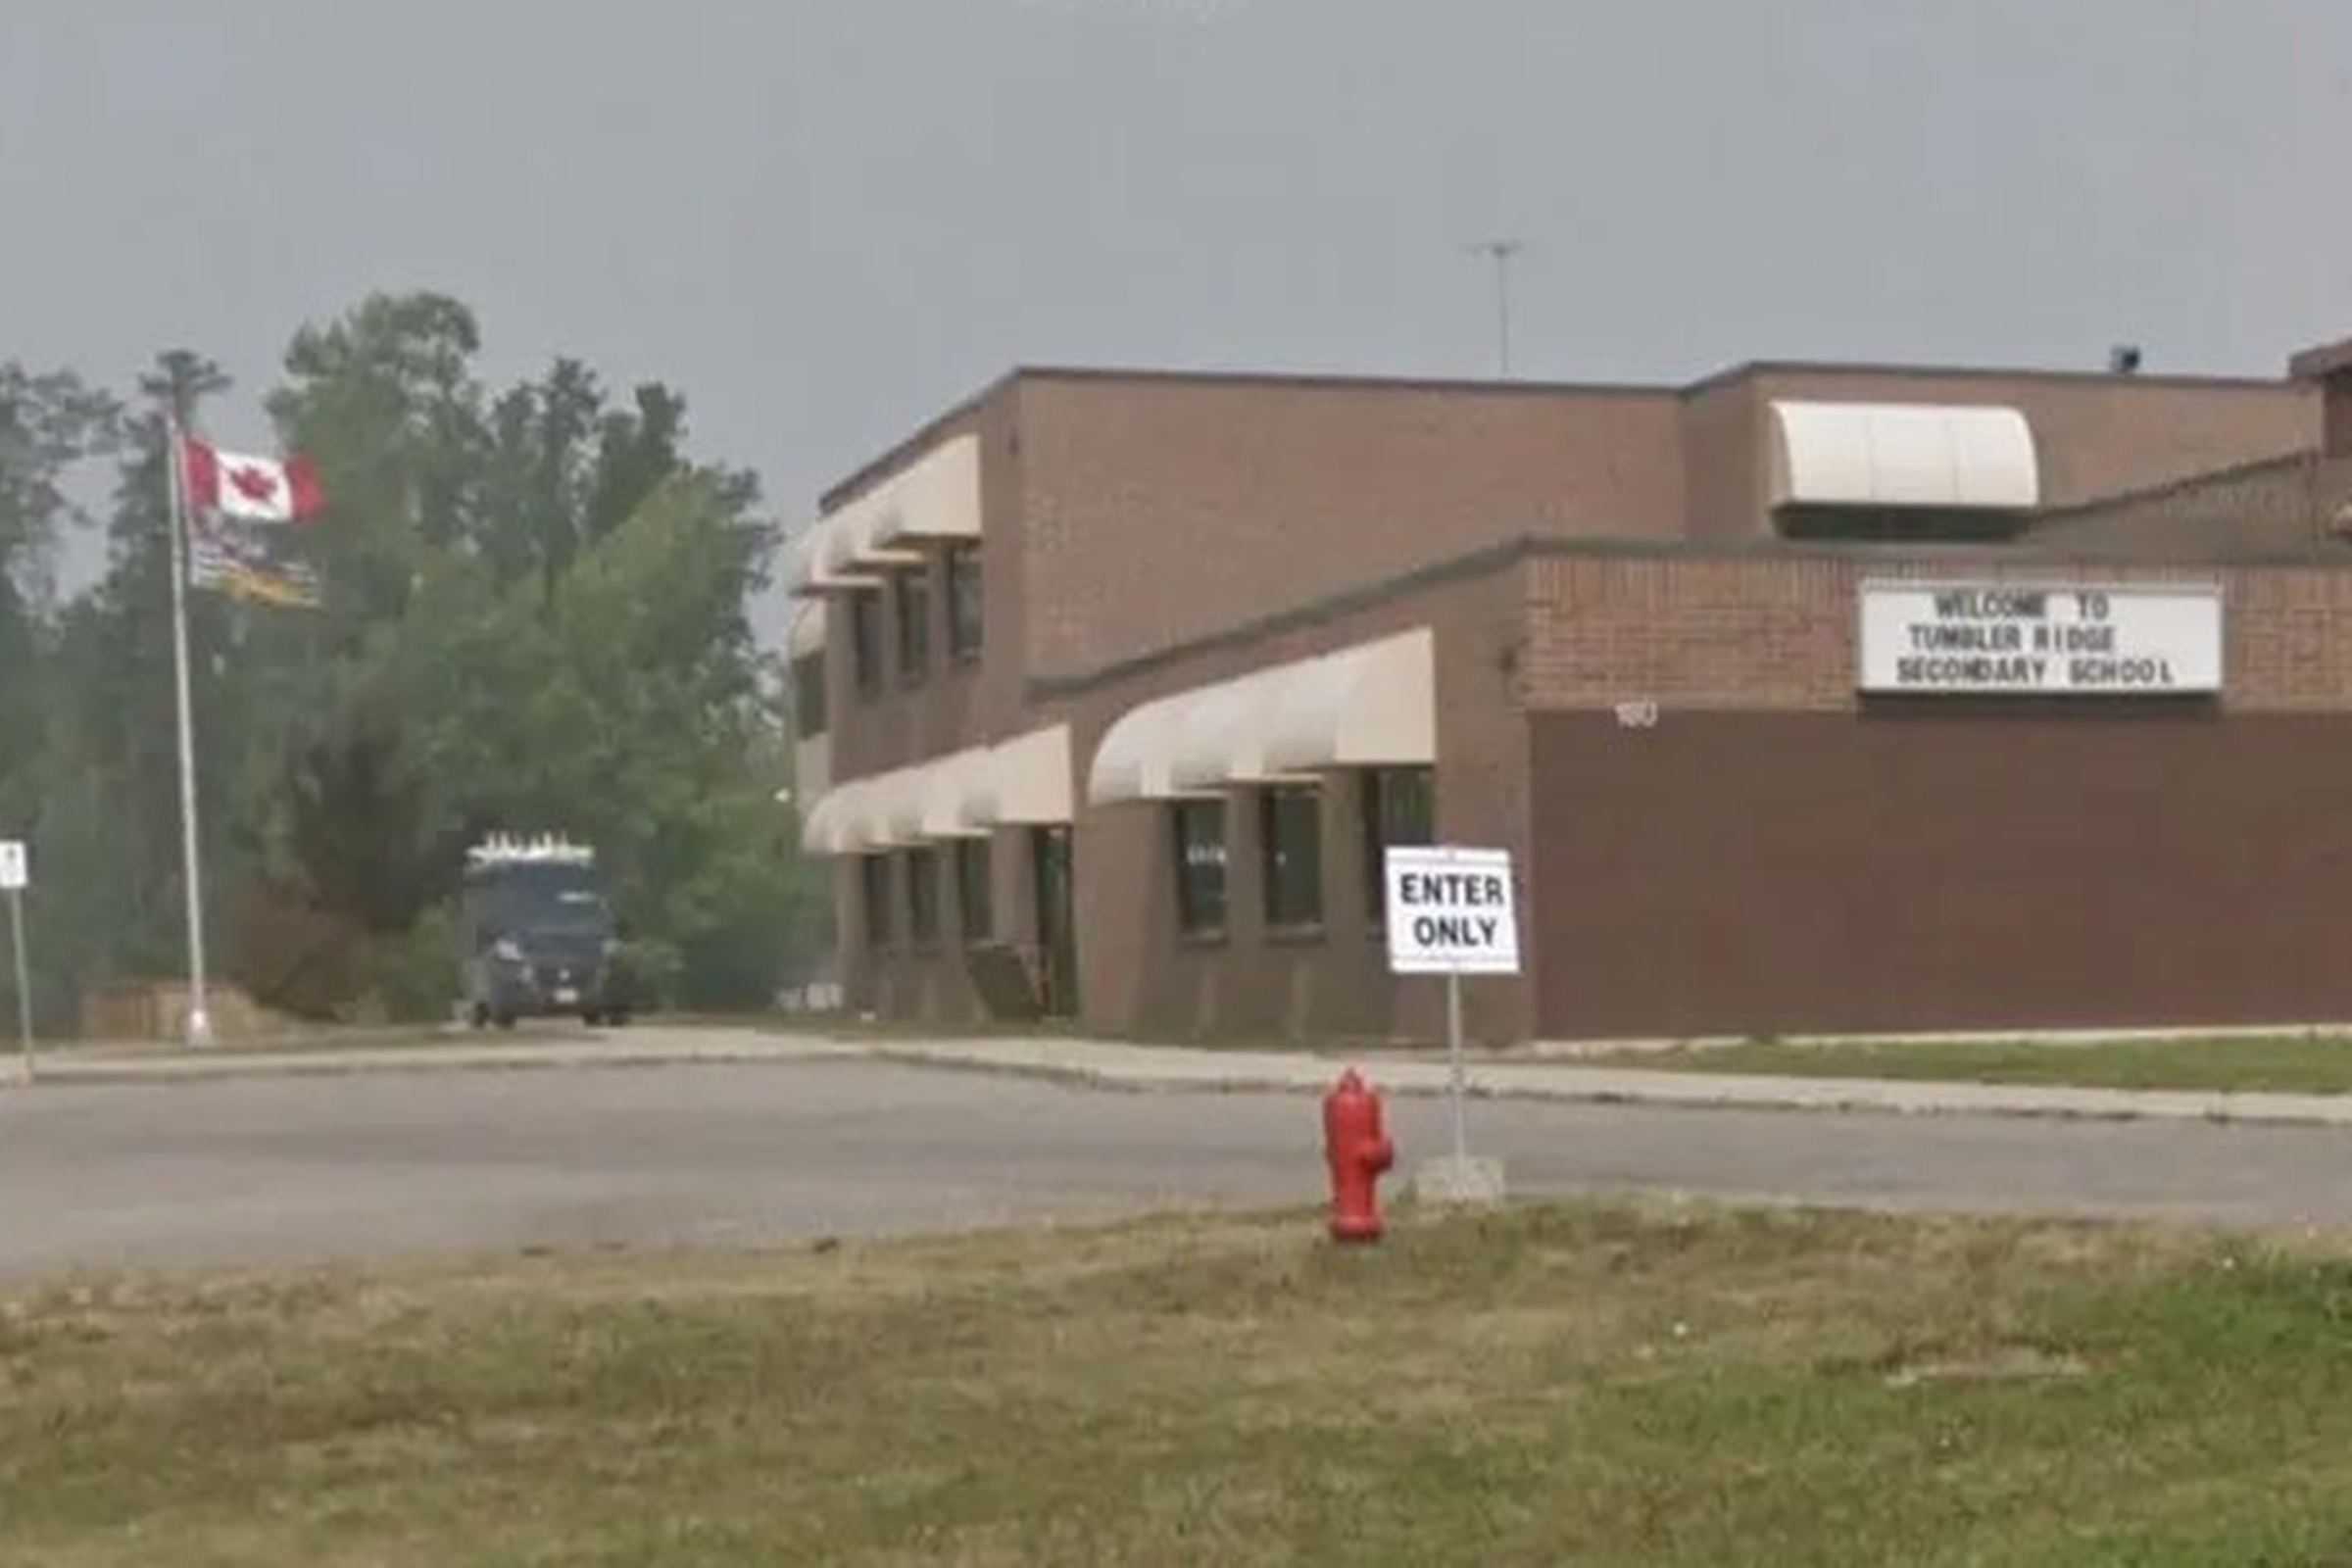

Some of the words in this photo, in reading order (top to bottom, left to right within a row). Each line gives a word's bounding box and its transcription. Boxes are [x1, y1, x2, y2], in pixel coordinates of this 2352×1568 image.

[1936, 590, 2046, 618] WELCOME
[2074, 590, 2109, 619] TO
[1908, 624, 2022, 651] TUMBLER
[2034, 625, 2115, 652] RIDGE
[1896, 657, 2046, 683] SECONDARY
[2070, 658, 2174, 684] SCHOOL
[1400, 873, 1504, 906] ENTER
[1413, 915, 1496, 948] ONLY
